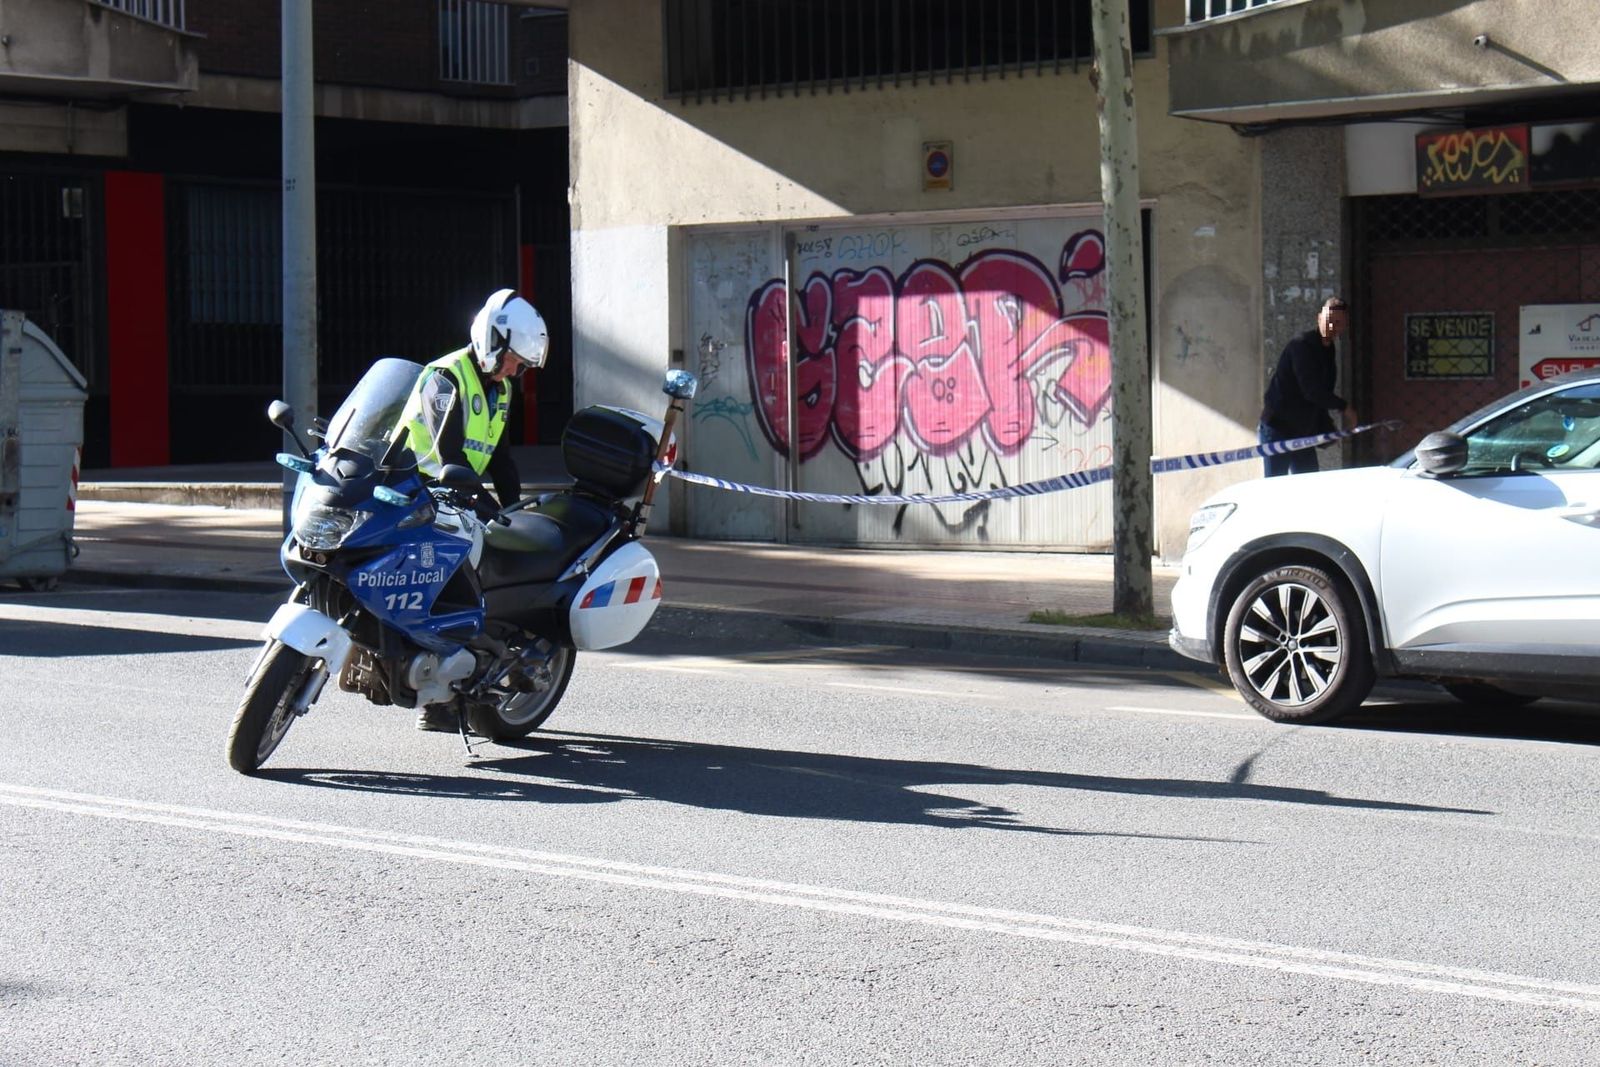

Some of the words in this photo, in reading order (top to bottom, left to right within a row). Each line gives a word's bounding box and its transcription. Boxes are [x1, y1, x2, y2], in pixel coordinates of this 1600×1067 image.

[1410, 318, 1430, 337] SE
[1435, 318, 1490, 337] VENDE
[358, 570, 407, 587] Policía
[411, 567, 444, 585] Local
[385, 592, 424, 610] 112
